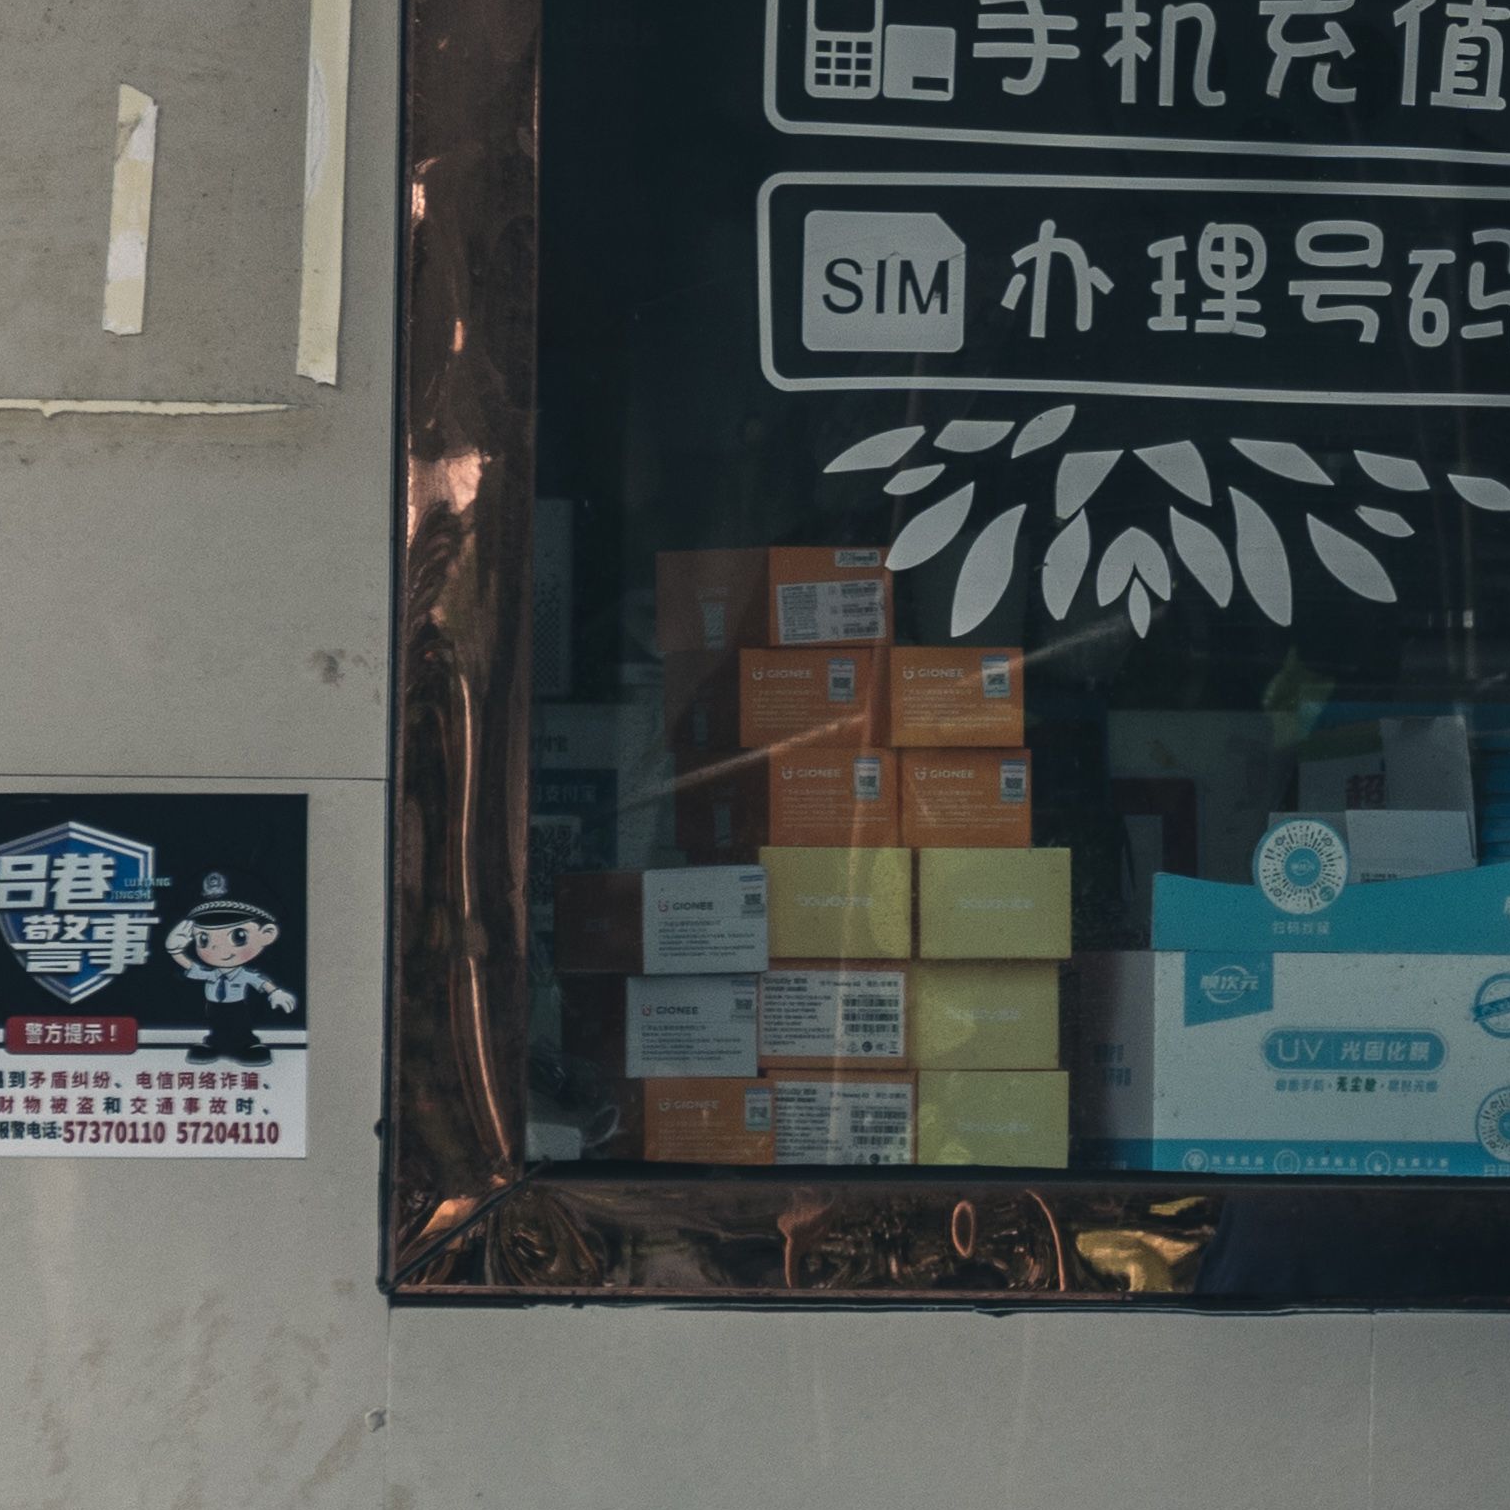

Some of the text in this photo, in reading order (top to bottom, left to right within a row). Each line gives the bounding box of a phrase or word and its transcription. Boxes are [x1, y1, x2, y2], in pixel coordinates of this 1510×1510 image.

[821, 257, 950, 317] SIM
[672, 902, 714, 911] GIONEE
[10, 914, 160, 975] 警事
[656, 1006, 699, 1015] GIONEE
[1277, 1039, 1324, 1061] UV
[176, 1120, 280, 1145] 57204110
